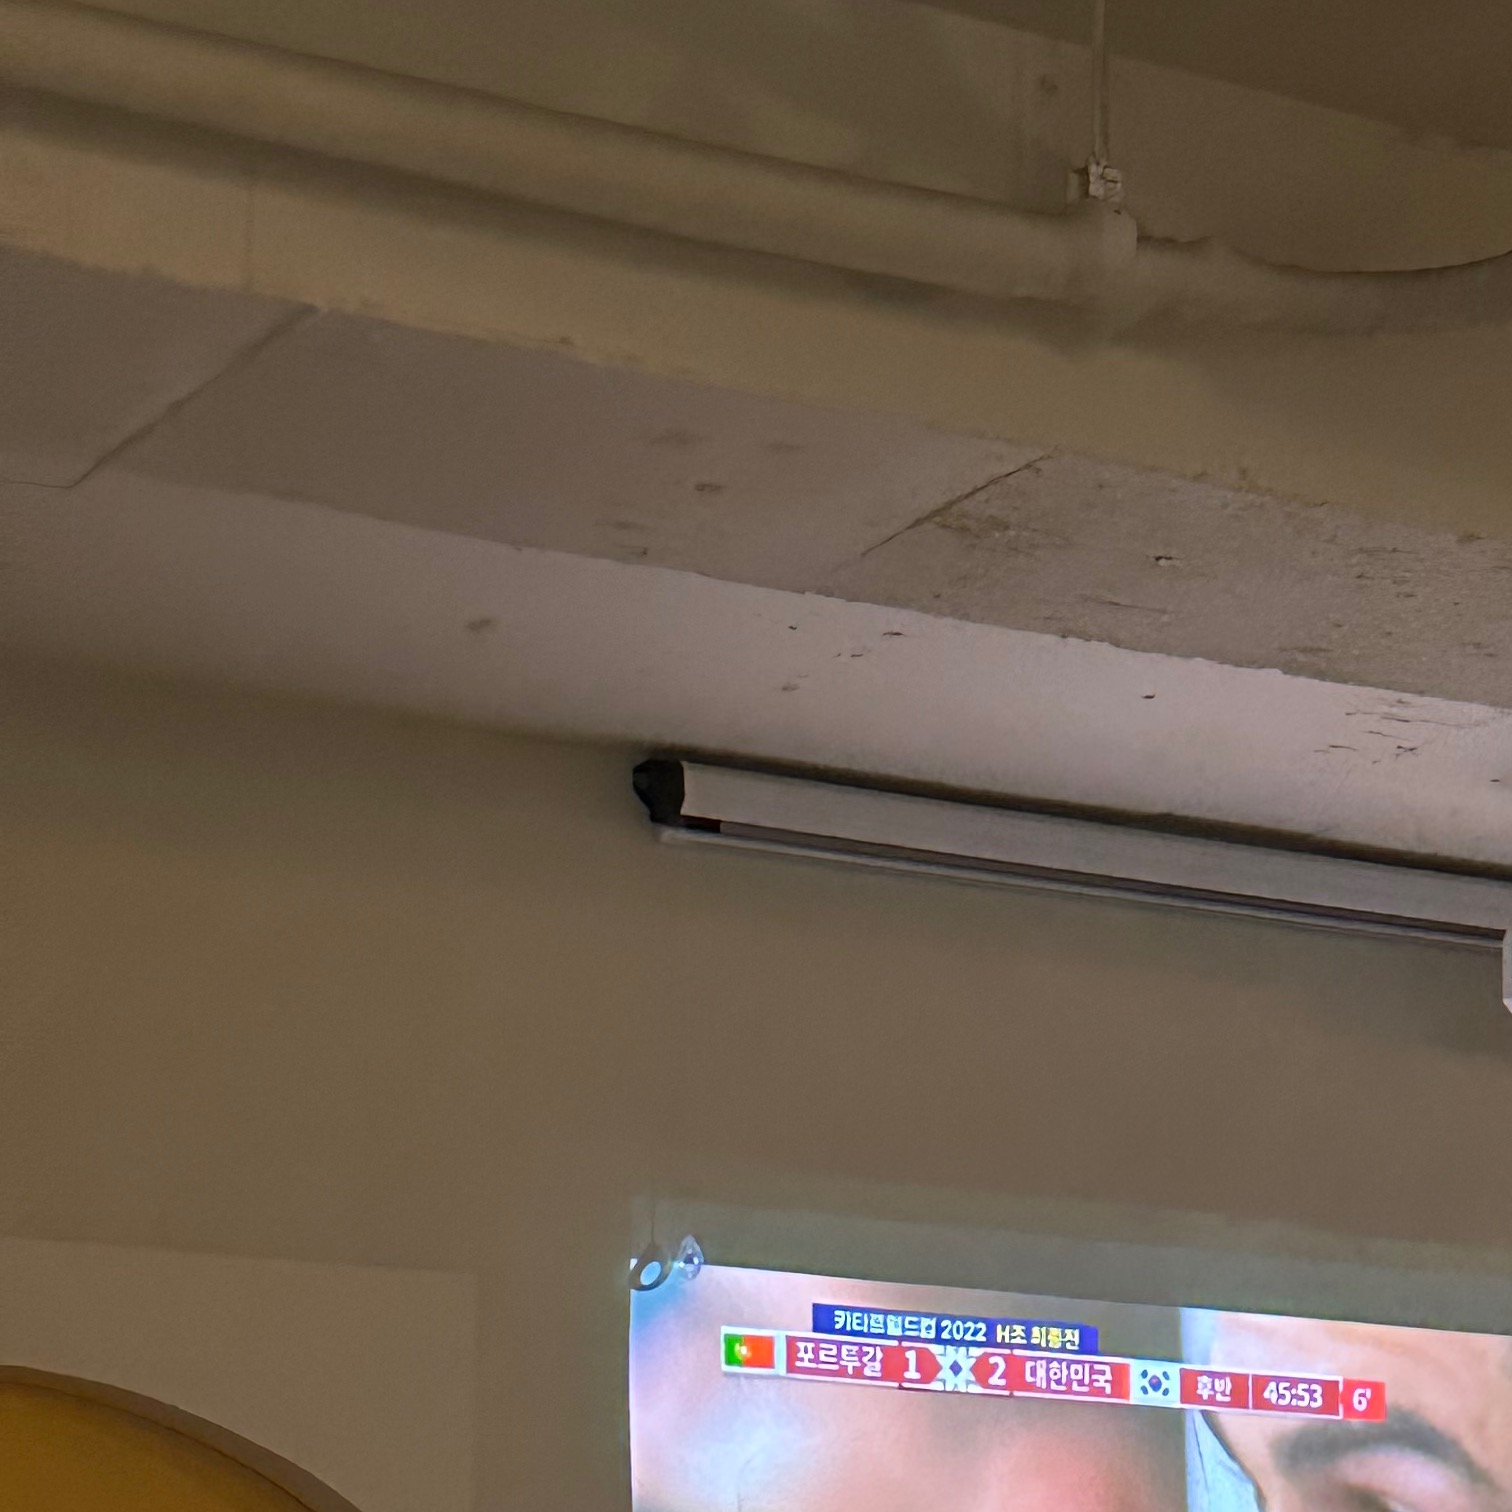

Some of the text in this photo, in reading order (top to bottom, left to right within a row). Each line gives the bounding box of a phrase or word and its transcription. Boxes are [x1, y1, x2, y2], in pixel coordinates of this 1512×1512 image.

[940, 1319, 987, 1342] 2022
[996, 1324, 1028, 1345] H조
[794, 1341, 884, 1378] 포르투갈
[903, 1349, 922, 1380] 1
[987, 1355, 1007, 1387] 2
[1025, 1359, 1113, 1395] 대한민국
[1196, 1375, 1233, 1402] 후반
[1262, 1380, 1323, 1408] 45:53
